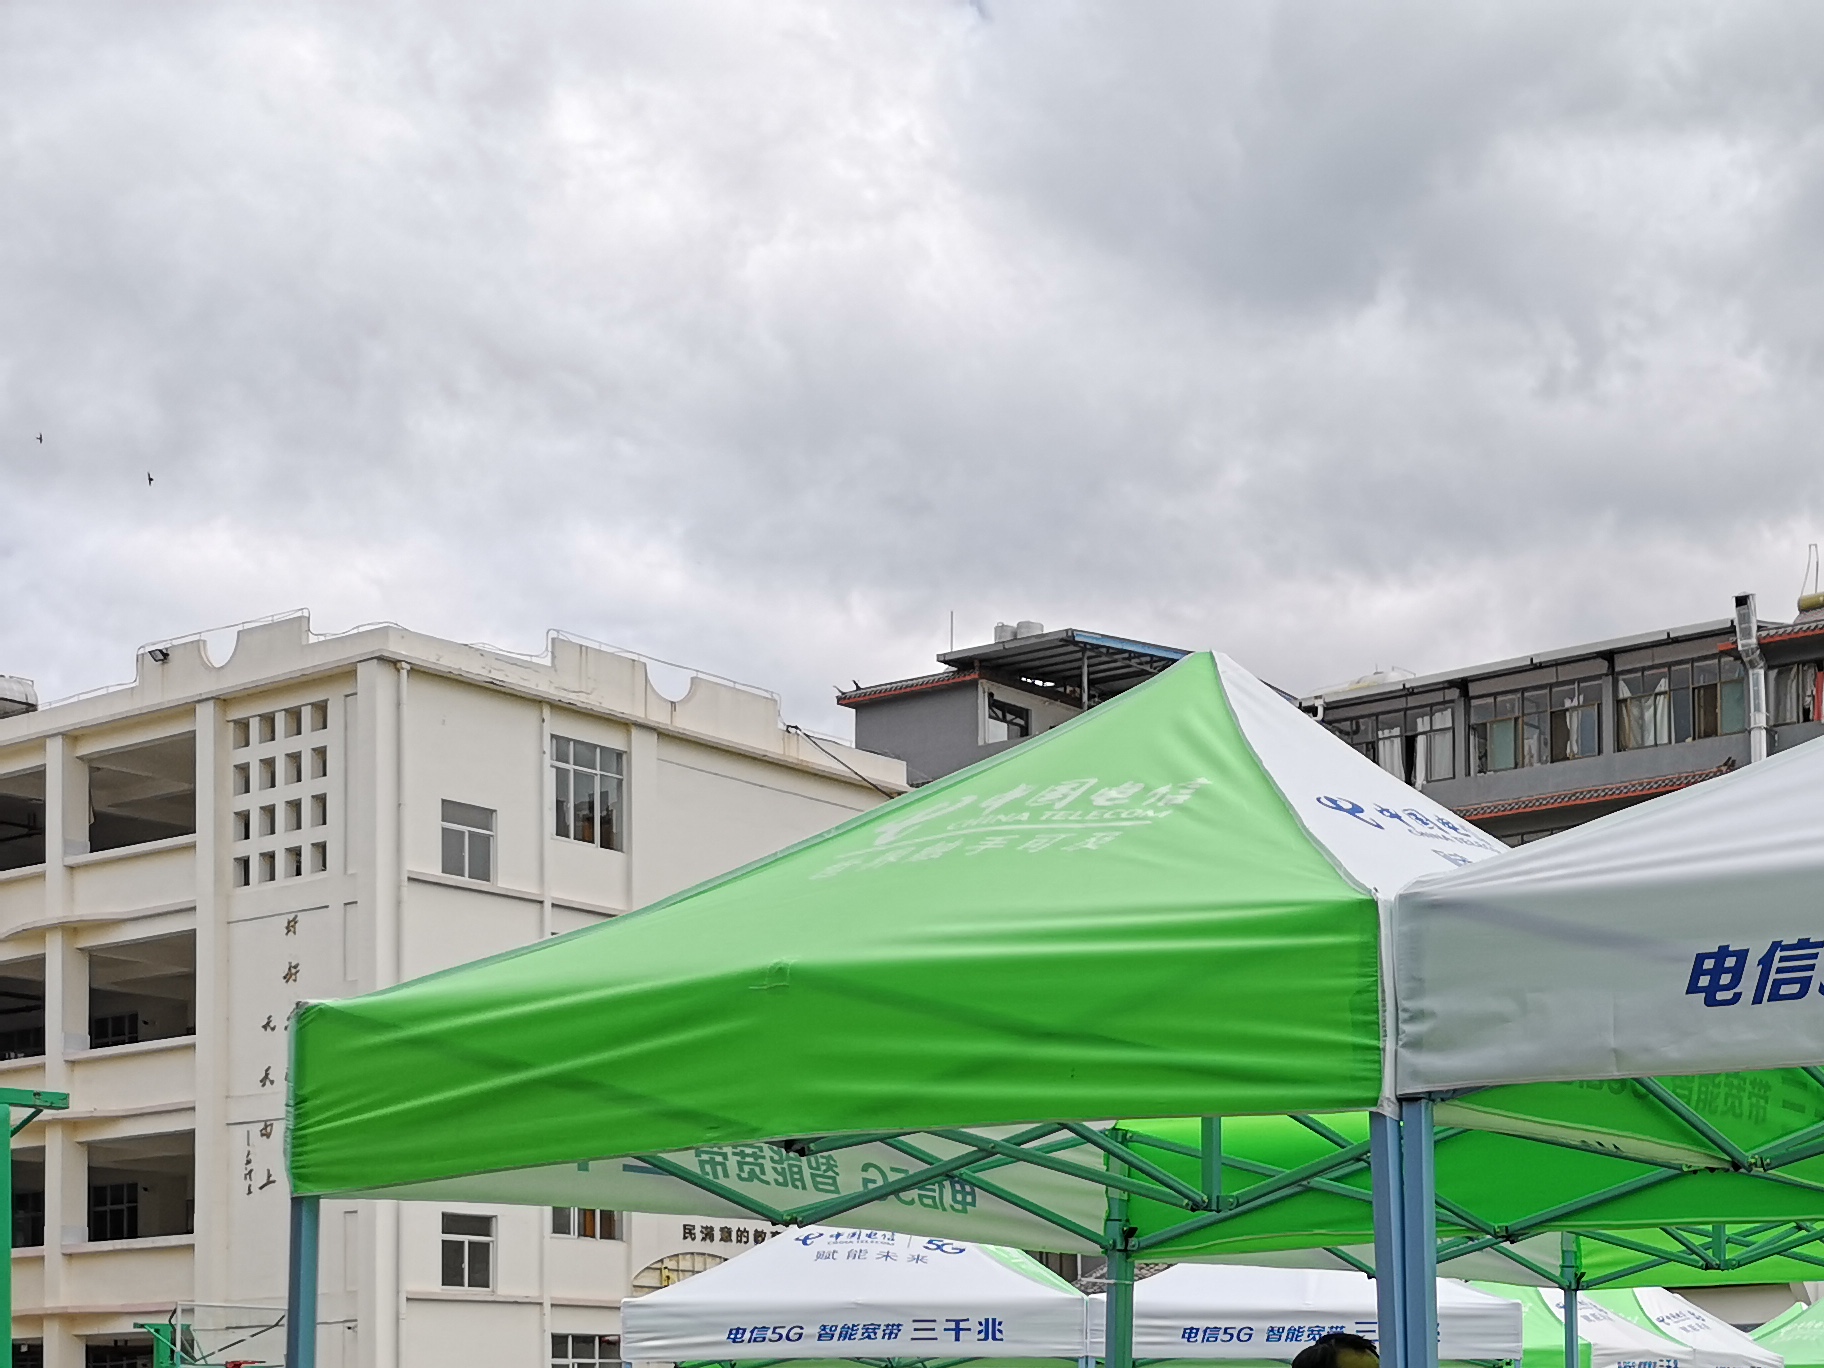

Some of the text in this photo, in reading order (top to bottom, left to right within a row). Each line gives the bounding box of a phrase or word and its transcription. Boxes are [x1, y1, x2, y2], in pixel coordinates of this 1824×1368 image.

[946, 808, 1172, 830] CHINA TELECOM
[922, 1239, 967, 1255] 5G
[814, 1248, 929, 1265] 赋能未来
[726, 1317, 1005, 1344] 电信5G 智能宽带 三千兆
[1181, 1326, 1255, 1344] 电信5G
